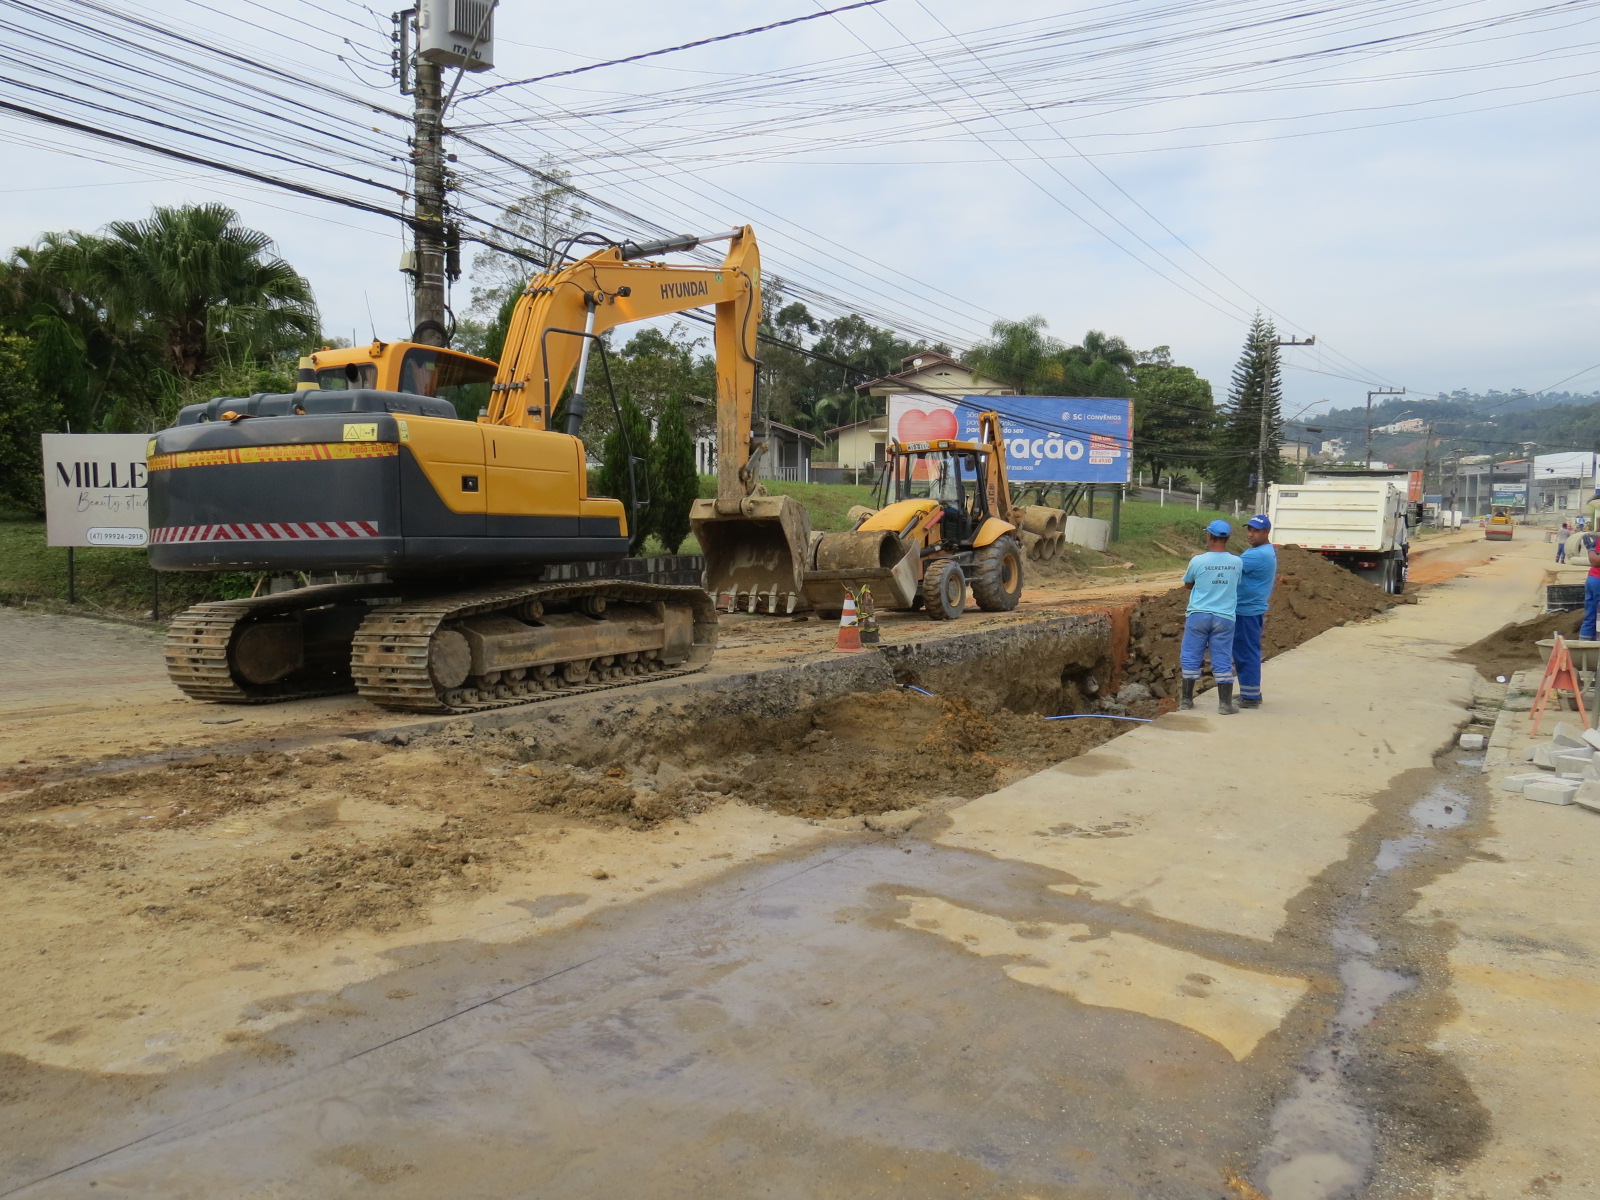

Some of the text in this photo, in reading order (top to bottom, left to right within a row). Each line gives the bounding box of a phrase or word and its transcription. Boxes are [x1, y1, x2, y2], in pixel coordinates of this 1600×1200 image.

[660, 281, 708, 299] HYUNDAI
[1086, 413, 1122, 421] CONVÊNIOS
[56, 462, 148, 488] MILLE
[77, 491, 120, 512] Beauty
[89, 532, 144, 541] (47) 99924-2918
